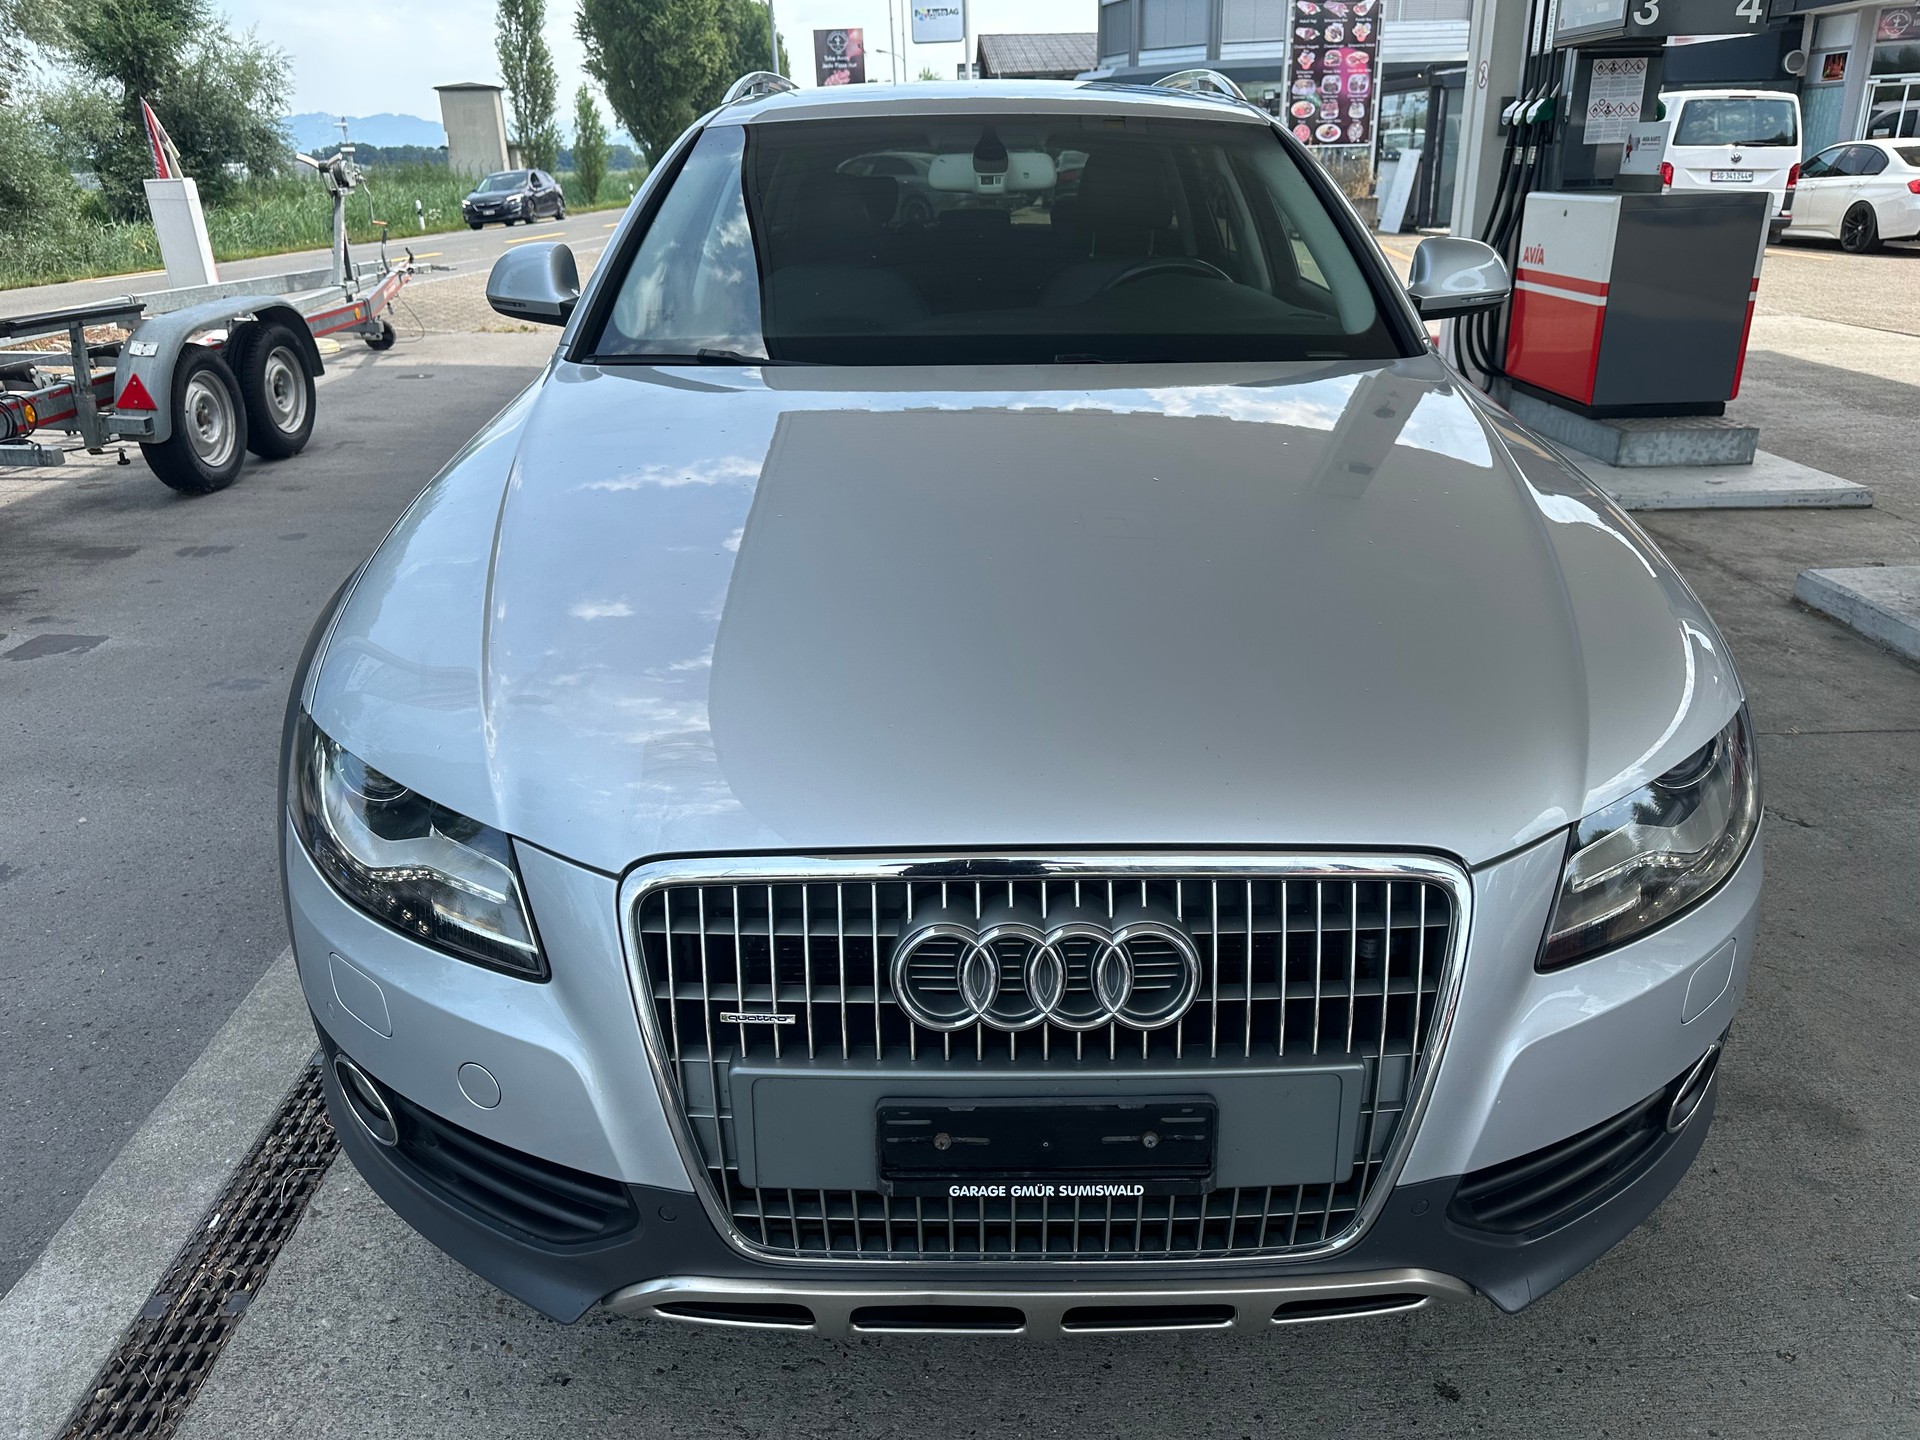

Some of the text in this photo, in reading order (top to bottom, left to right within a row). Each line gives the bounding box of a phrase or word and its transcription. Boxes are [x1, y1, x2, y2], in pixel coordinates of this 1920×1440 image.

[1633, 0, 1660, 26] 3
[1735, 0, 1763, 24] 4
[949, 1183, 1145, 1197] GARAGE GMÜR SUMISWALD
